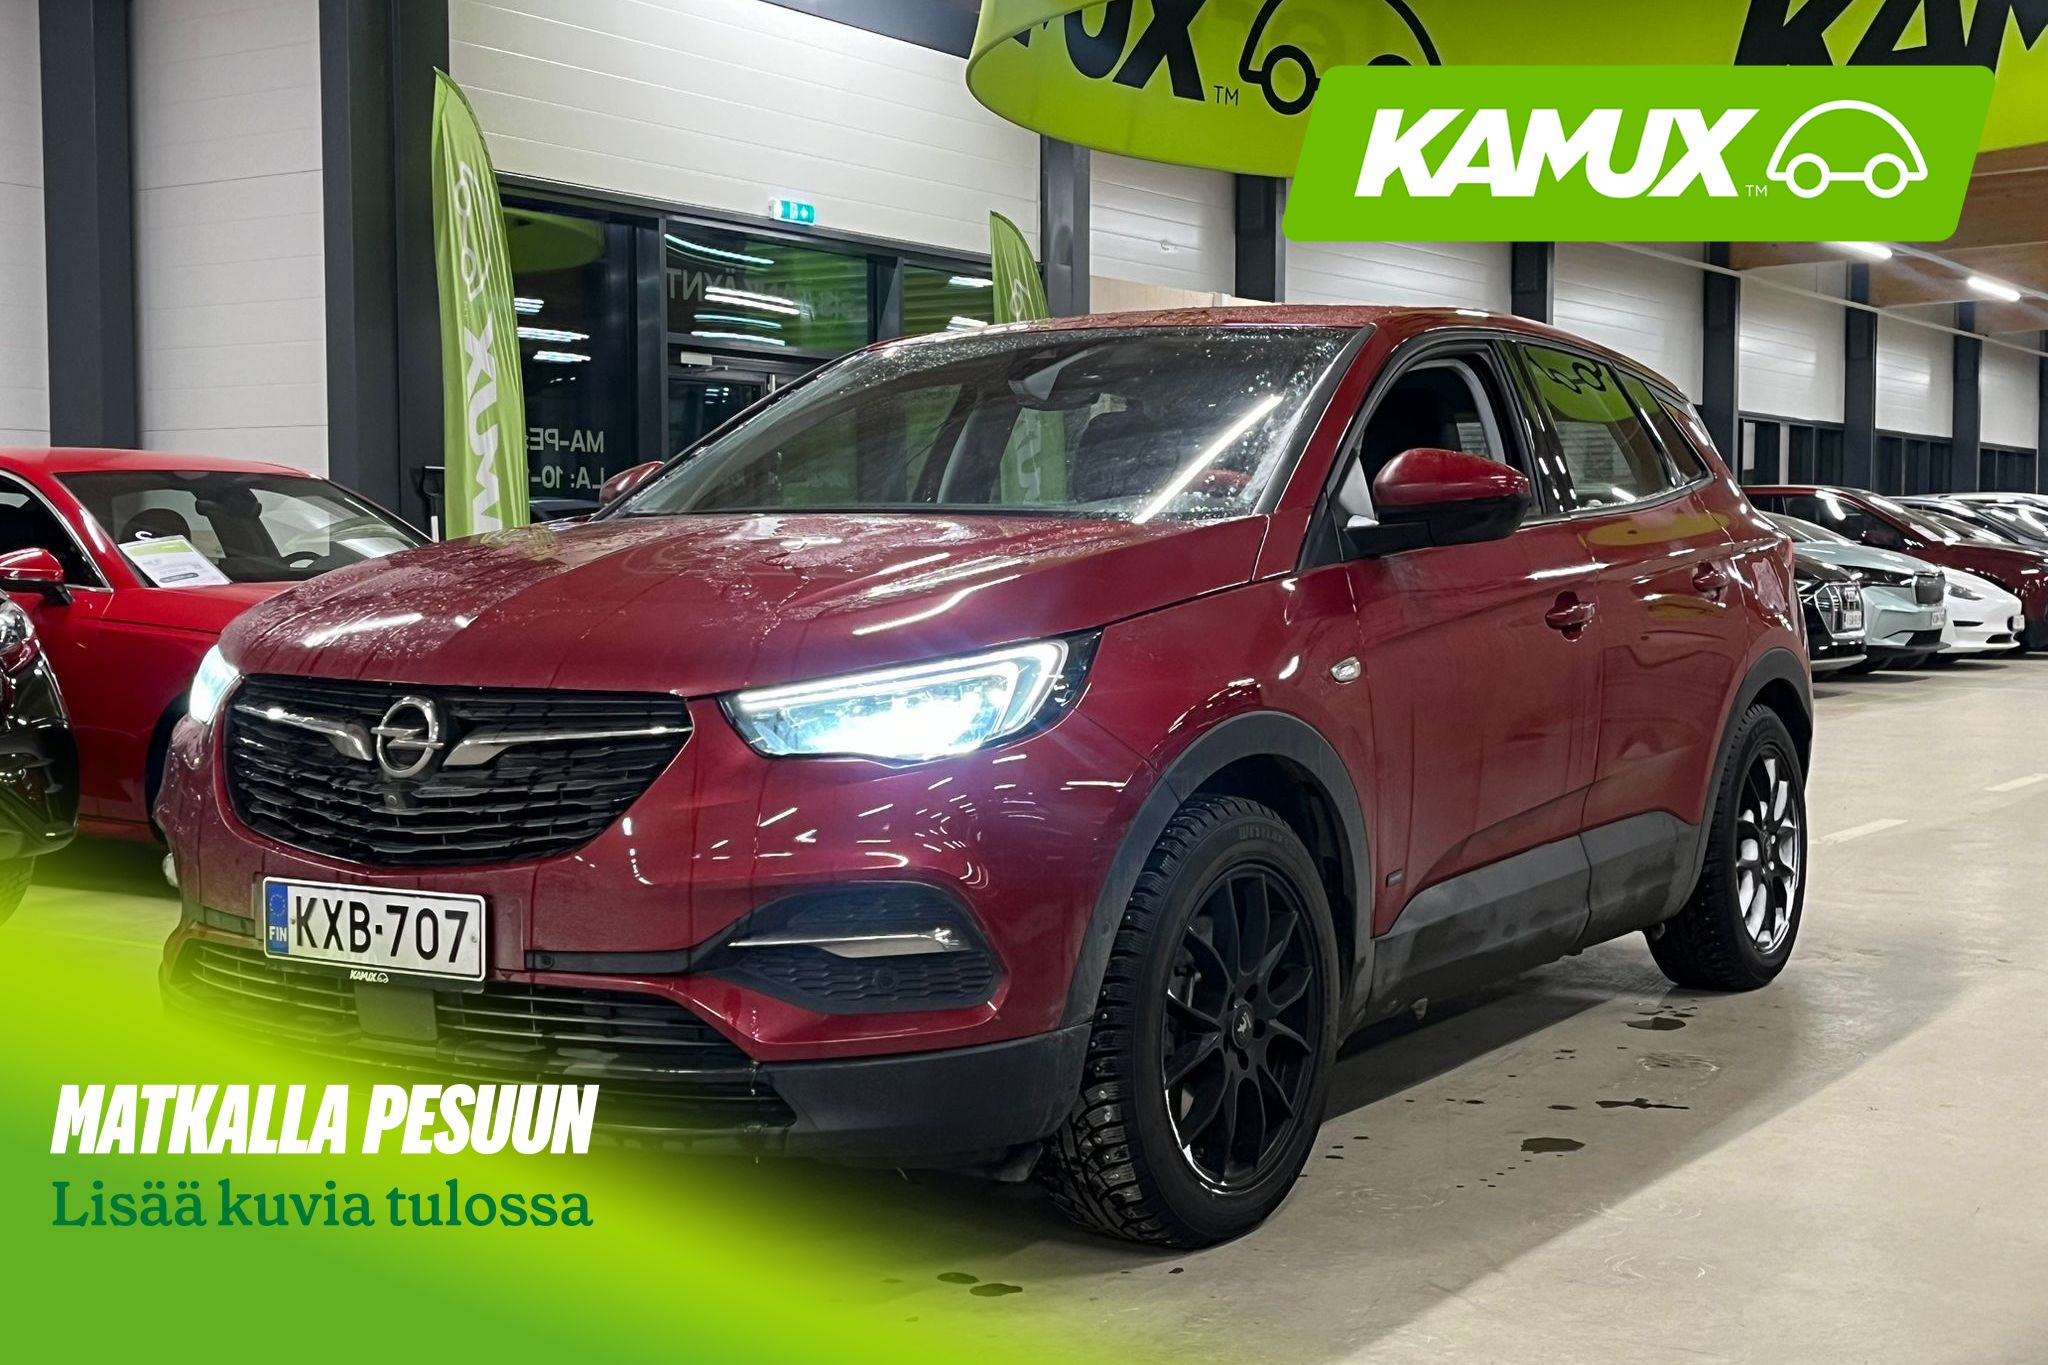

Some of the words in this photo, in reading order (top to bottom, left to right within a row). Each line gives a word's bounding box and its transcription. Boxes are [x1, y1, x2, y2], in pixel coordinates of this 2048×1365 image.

[1012, 0, 1206, 102] UX
[1213, 85, 1240, 106] TM
[269, 926, 288, 942] FIN
[296, 895, 469, 963] KXB-707
[349, 969, 378, 982] KAMUX
